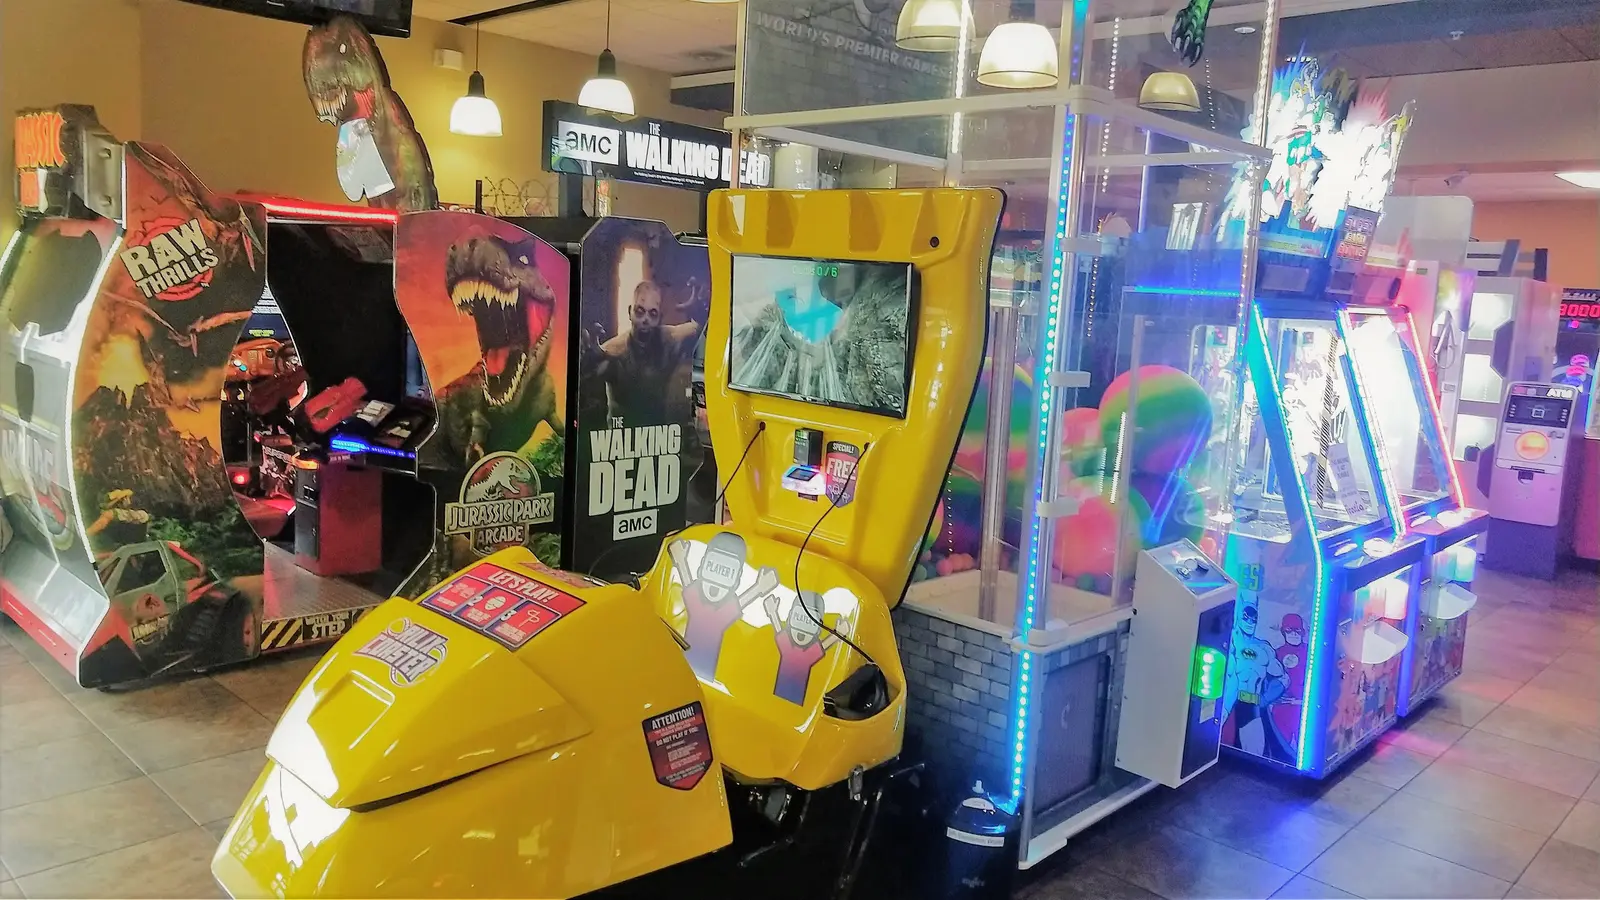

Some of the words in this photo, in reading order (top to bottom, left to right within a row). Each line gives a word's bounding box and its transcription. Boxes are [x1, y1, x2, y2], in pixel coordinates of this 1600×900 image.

[835, 35, 899, 64] PREMIER
[649, 122, 661, 136] THE
[625, 131, 720, 180] WALKING
[119, 217, 207, 281] RAW
[135, 246, 219, 298] THRILLS
[612, 416, 624, 428] THE
[589, 424, 681, 462] WALKING
[1, 429, 56, 496] ARADE
[826, 457, 857, 481] FREE
[588, 454, 681, 517] DEAD
[448, 502, 513, 531] JURASSIC
[513, 498, 550, 522] PARK
[477, 526, 524, 546] ARCADE
[705, 560, 731, 580] PLAYER
[487, 570, 523, 593] LET'S
[517, 580, 561, 603] PLAY!
[311, 620, 346, 639] STEP
[354, 633, 438, 683] COASTER
[652, 706, 695, 730] ATTENTION!
[663, 736, 673, 745] NOT
[672, 732, 684, 741] PLAY
